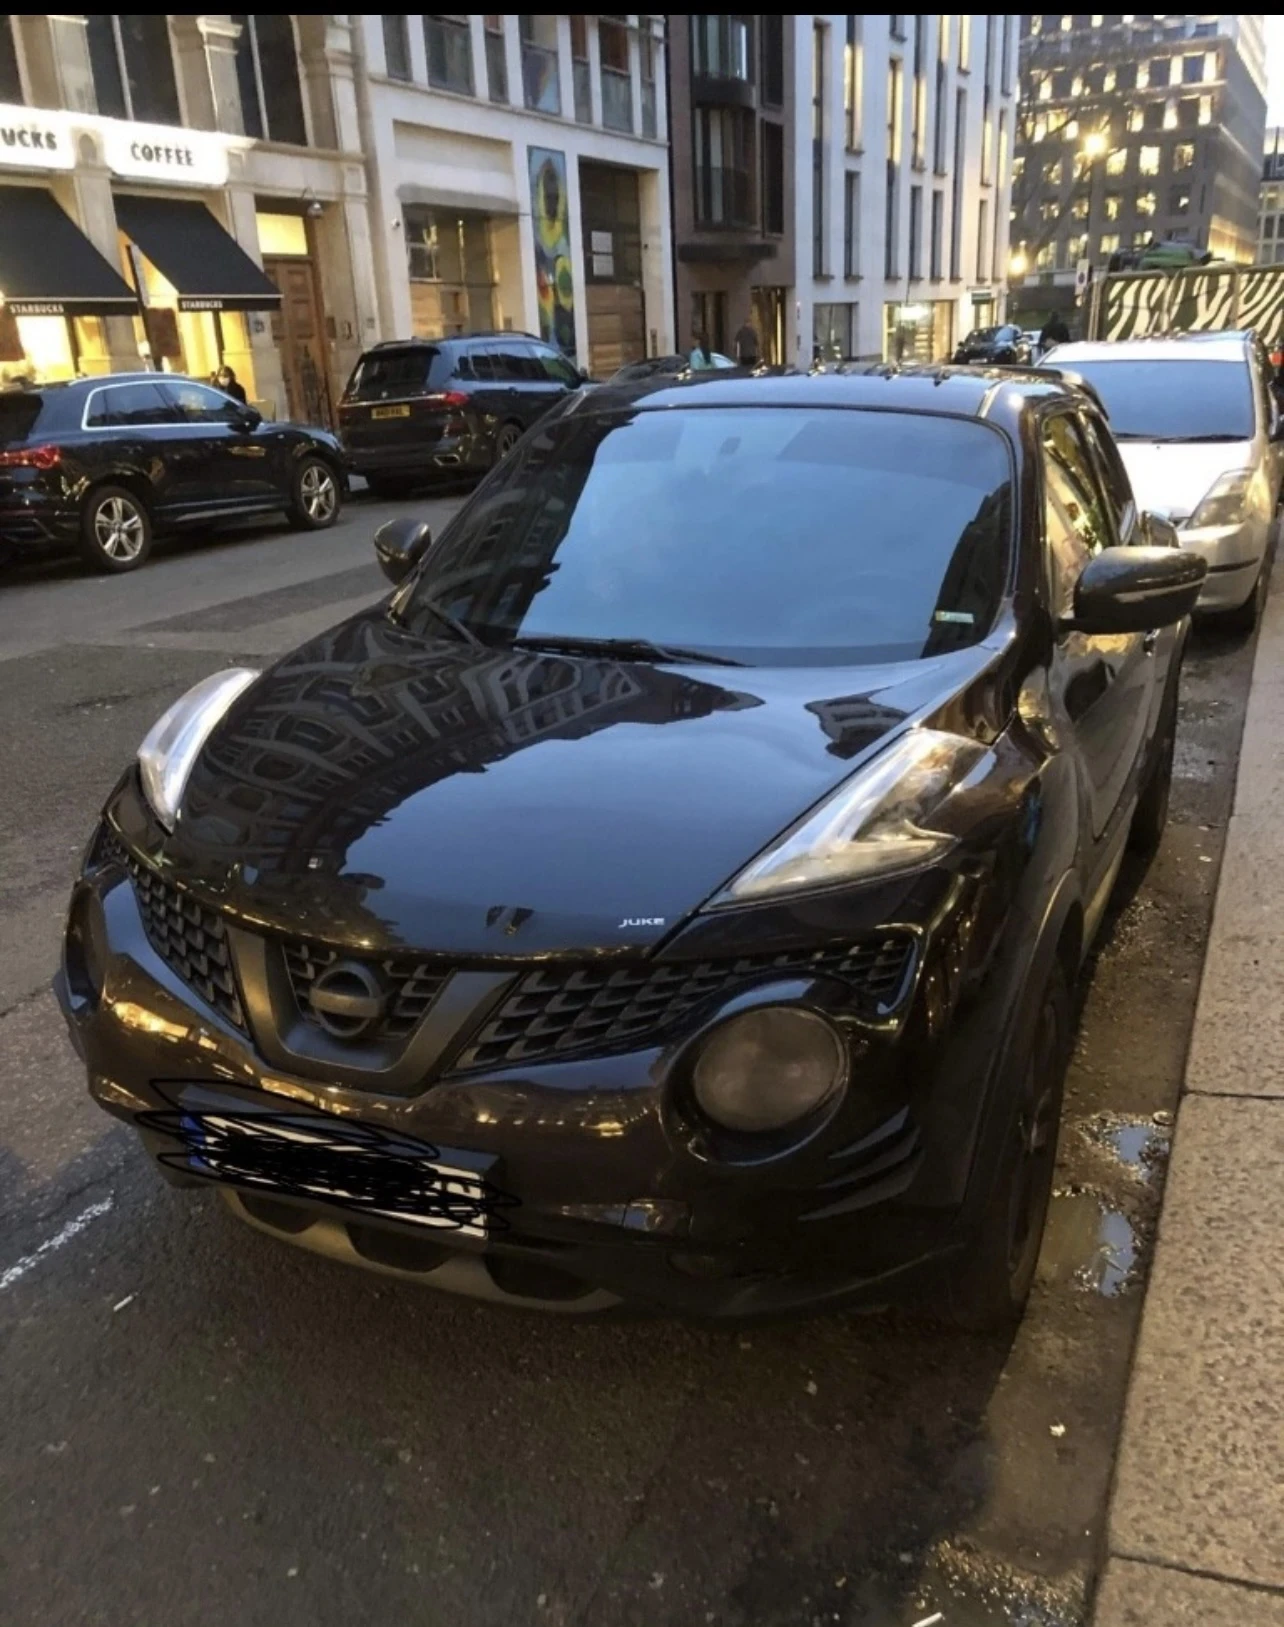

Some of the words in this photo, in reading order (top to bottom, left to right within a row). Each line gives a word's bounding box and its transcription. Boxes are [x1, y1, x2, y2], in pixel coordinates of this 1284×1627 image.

[1, 128, 58, 151] UCKS
[130, 142, 195, 167] COFFEE
[10, 303, 65, 314] STARBUCKS
[618, 917, 665, 928] JUKE
